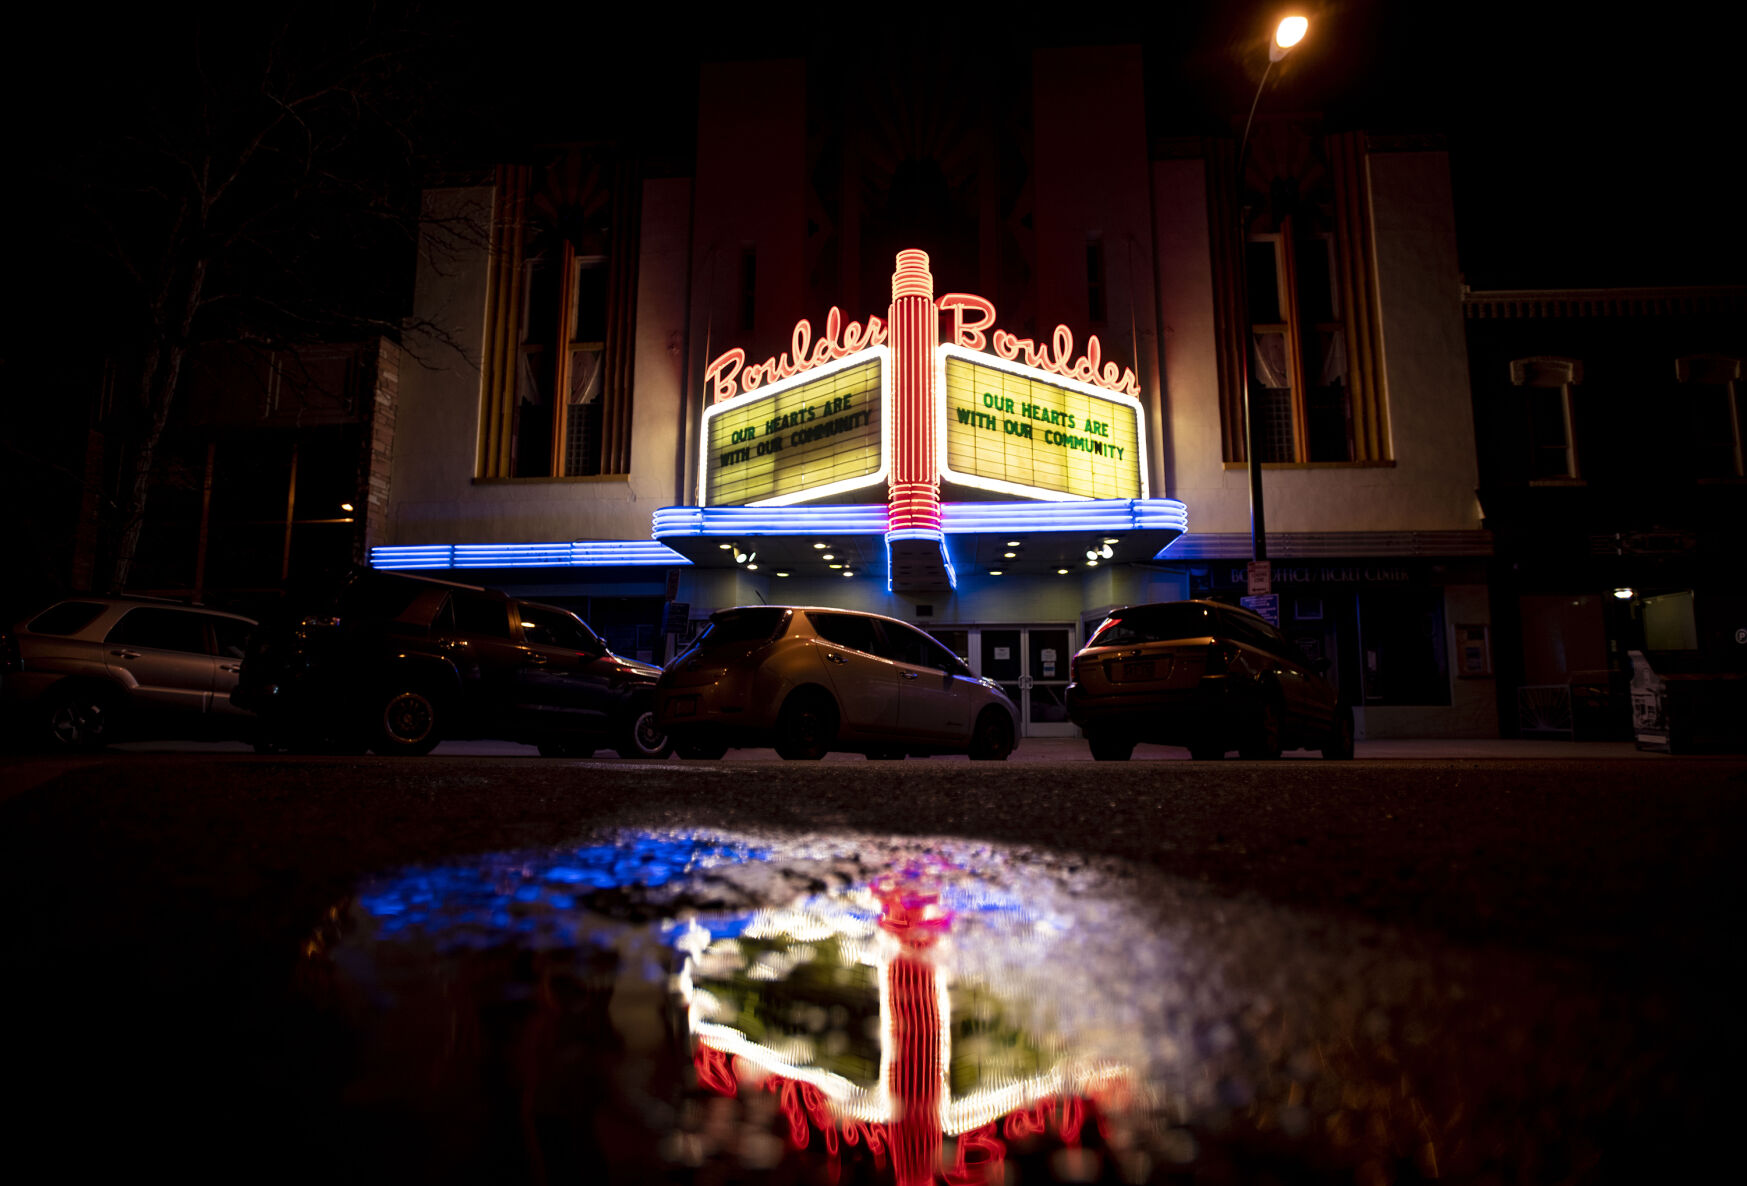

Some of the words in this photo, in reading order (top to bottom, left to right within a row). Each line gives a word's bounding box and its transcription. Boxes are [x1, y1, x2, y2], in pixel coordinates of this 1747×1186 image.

[705, 306, 888, 404] Boulder
[937, 293, 1141, 396] Boulder
[720, 447, 750, 467] WITH
[757, 437, 783, 457] OUR
[791, 409, 872, 447] COMMUNITY
[731, 426, 756, 444] OUR
[766, 405, 816, 436] HEARTS
[824, 393, 852, 417] ARE
[957, 407, 996, 431] WITH
[1004, 420, 1033, 440] OUR
[1045, 429, 1124, 460] COMMUNITY
[983, 393, 1014, 414] OUR
[1021, 402, 1075, 429] HEARTS
[1084, 419, 1108, 437] ARE
[1231, 568, 1248, 583] BO
